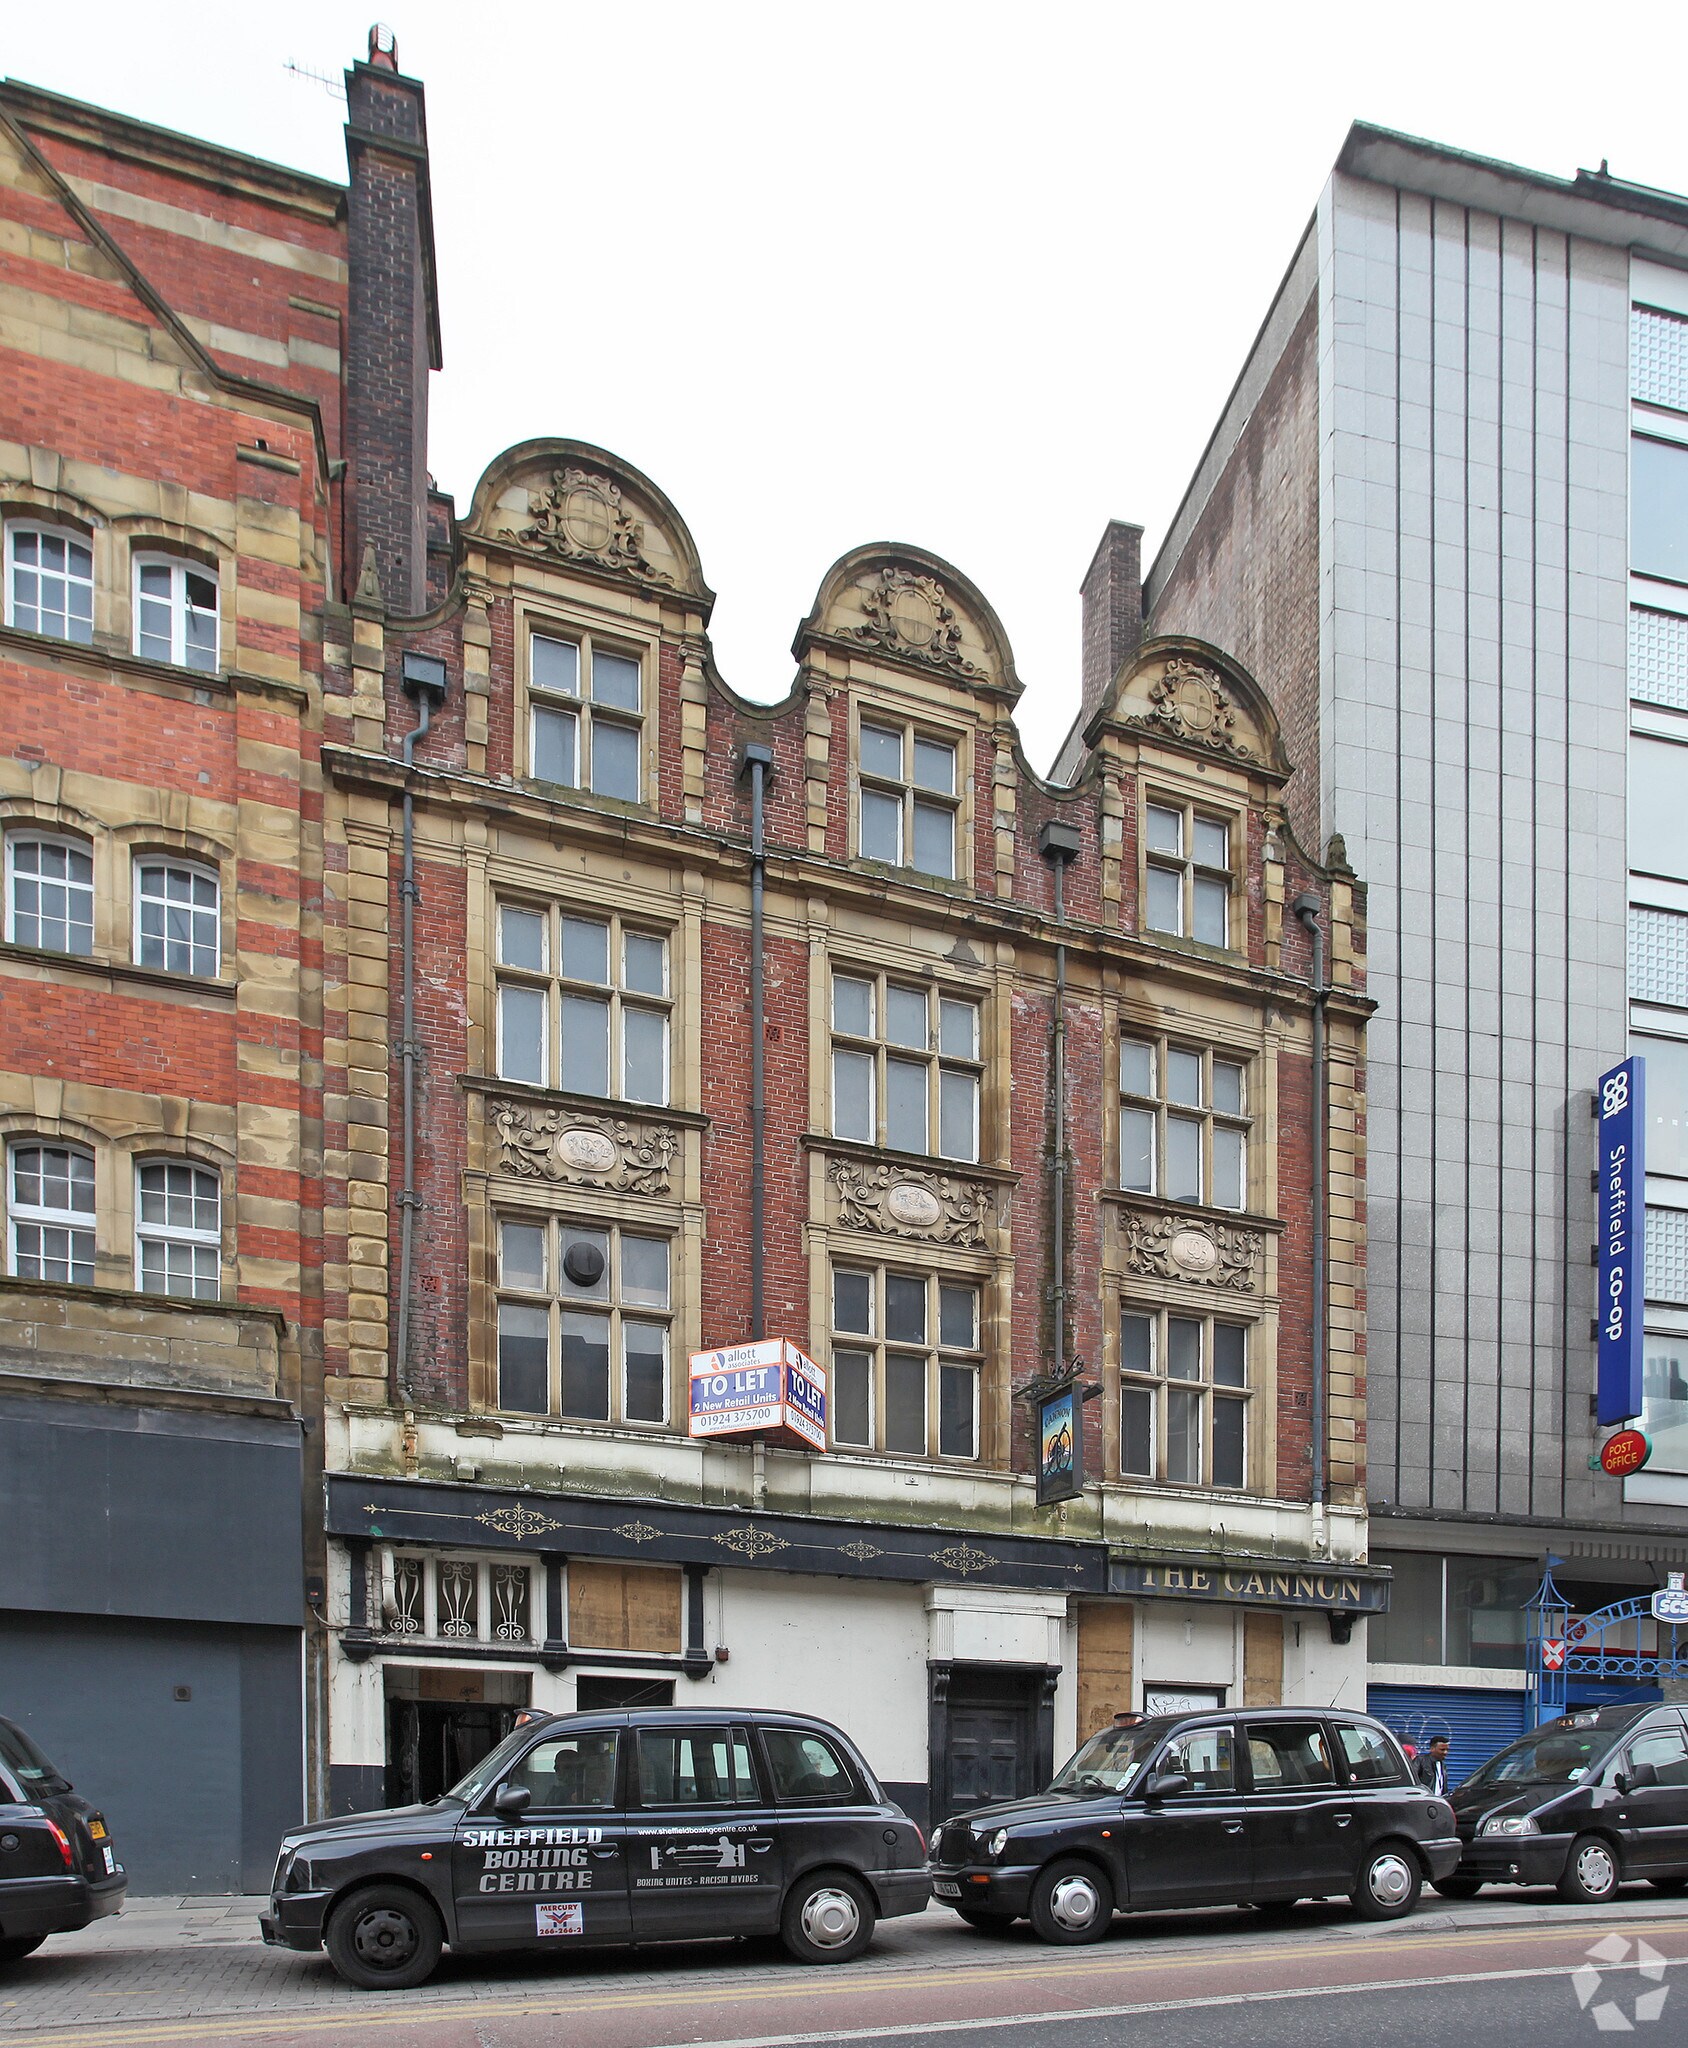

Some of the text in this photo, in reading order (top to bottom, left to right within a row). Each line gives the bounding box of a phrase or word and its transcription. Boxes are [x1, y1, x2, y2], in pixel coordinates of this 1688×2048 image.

[1605, 1145, 1626, 1342] Sheffield co-op
[728, 1349, 756, 1362] allott
[728, 1358, 761, 1369] associates
[701, 1369, 768, 1398] TO LET
[791, 1370, 822, 1411] TO LET
[694, 1393, 777, 1412] 2 New Retail Units
[700, 1408, 771, 1427] 01924 375700
[1609, 1440, 1634, 1456] POST
[1605, 1452, 1638, 1469] OFFICE
[1142, 1566, 1362, 1602] THE CANNON
[463, 1827, 603, 1847] SHEFFIELD
[637, 1824, 759, 1836] www.sheffieldboxingcentre.co.uk
[482, 1847, 589, 1870] BOXING
[479, 1870, 593, 1893] CENTRE
[636, 1877, 665, 1887] BOXING
[665, 1875, 693, 1886] UNITES
[699, 1875, 729, 1885] RACISM
[730, 1874, 759, 1884] DIVIDES
[540, 1903, 578, 1912] MERCURY
[539, 1927, 582, 1936] 266-266-2
